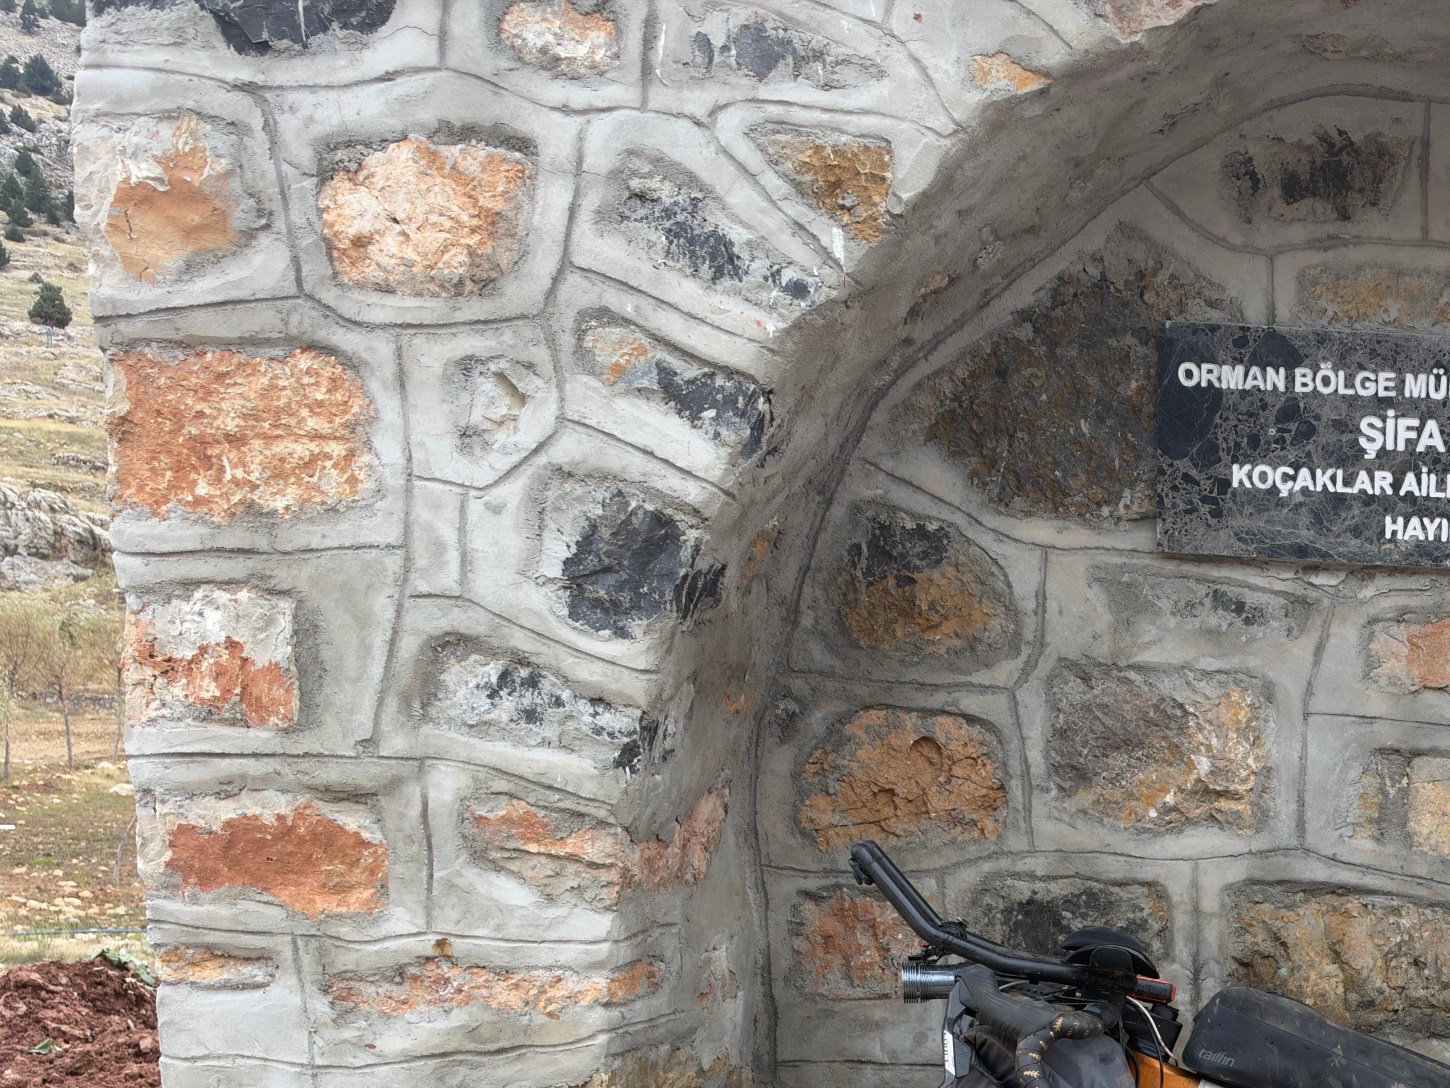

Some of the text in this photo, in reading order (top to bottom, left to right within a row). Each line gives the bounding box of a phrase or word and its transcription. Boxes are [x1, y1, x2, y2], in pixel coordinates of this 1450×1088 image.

[1177, 361, 1286, 392] ORMAN
[1294, 361, 1397, 398] BÖLGE
[1358, 408, 1446, 460] ŞİFA
[1231, 463, 1394, 498] KOÇAKLAR
[1198, 1048, 1236, 1067] tailfin
